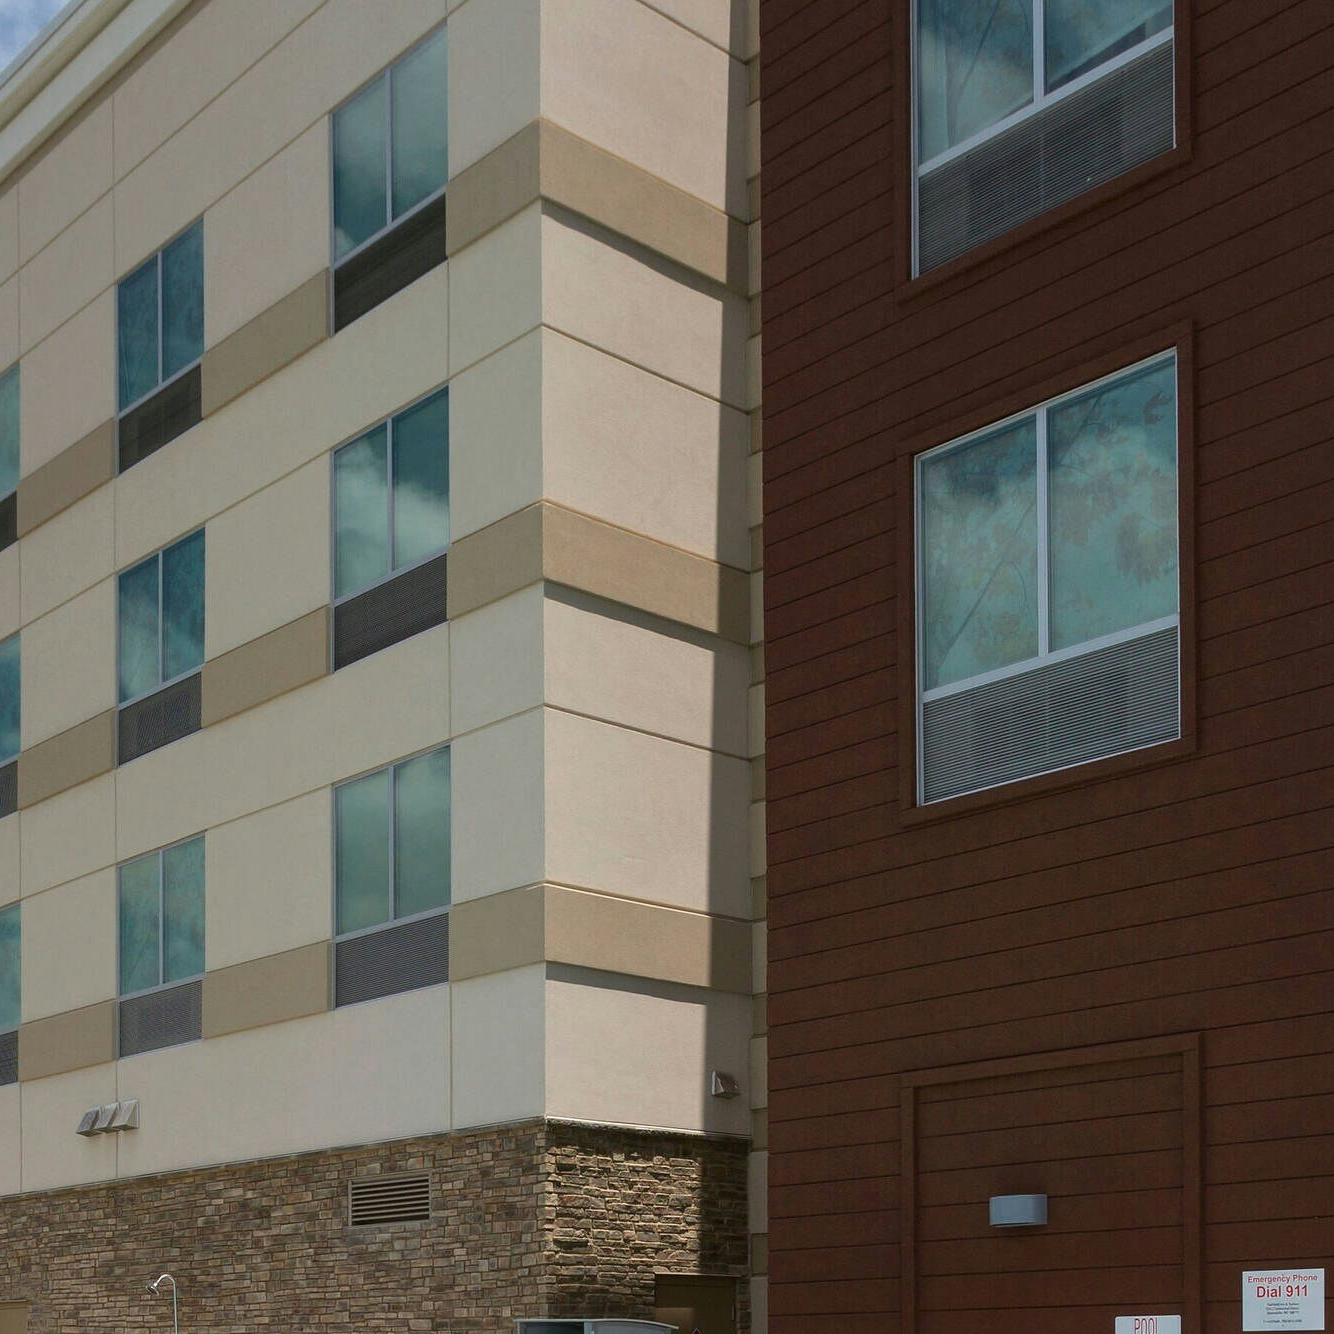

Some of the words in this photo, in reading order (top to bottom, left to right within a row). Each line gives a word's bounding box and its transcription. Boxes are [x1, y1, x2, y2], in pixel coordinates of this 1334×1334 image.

[1247, 1276, 1291, 1284] Emergency
[1292, 1274, 1318, 1282] Phone
[1256, 1286, 1282, 1298] Dial
[1286, 1284, 1308, 1297] 911
